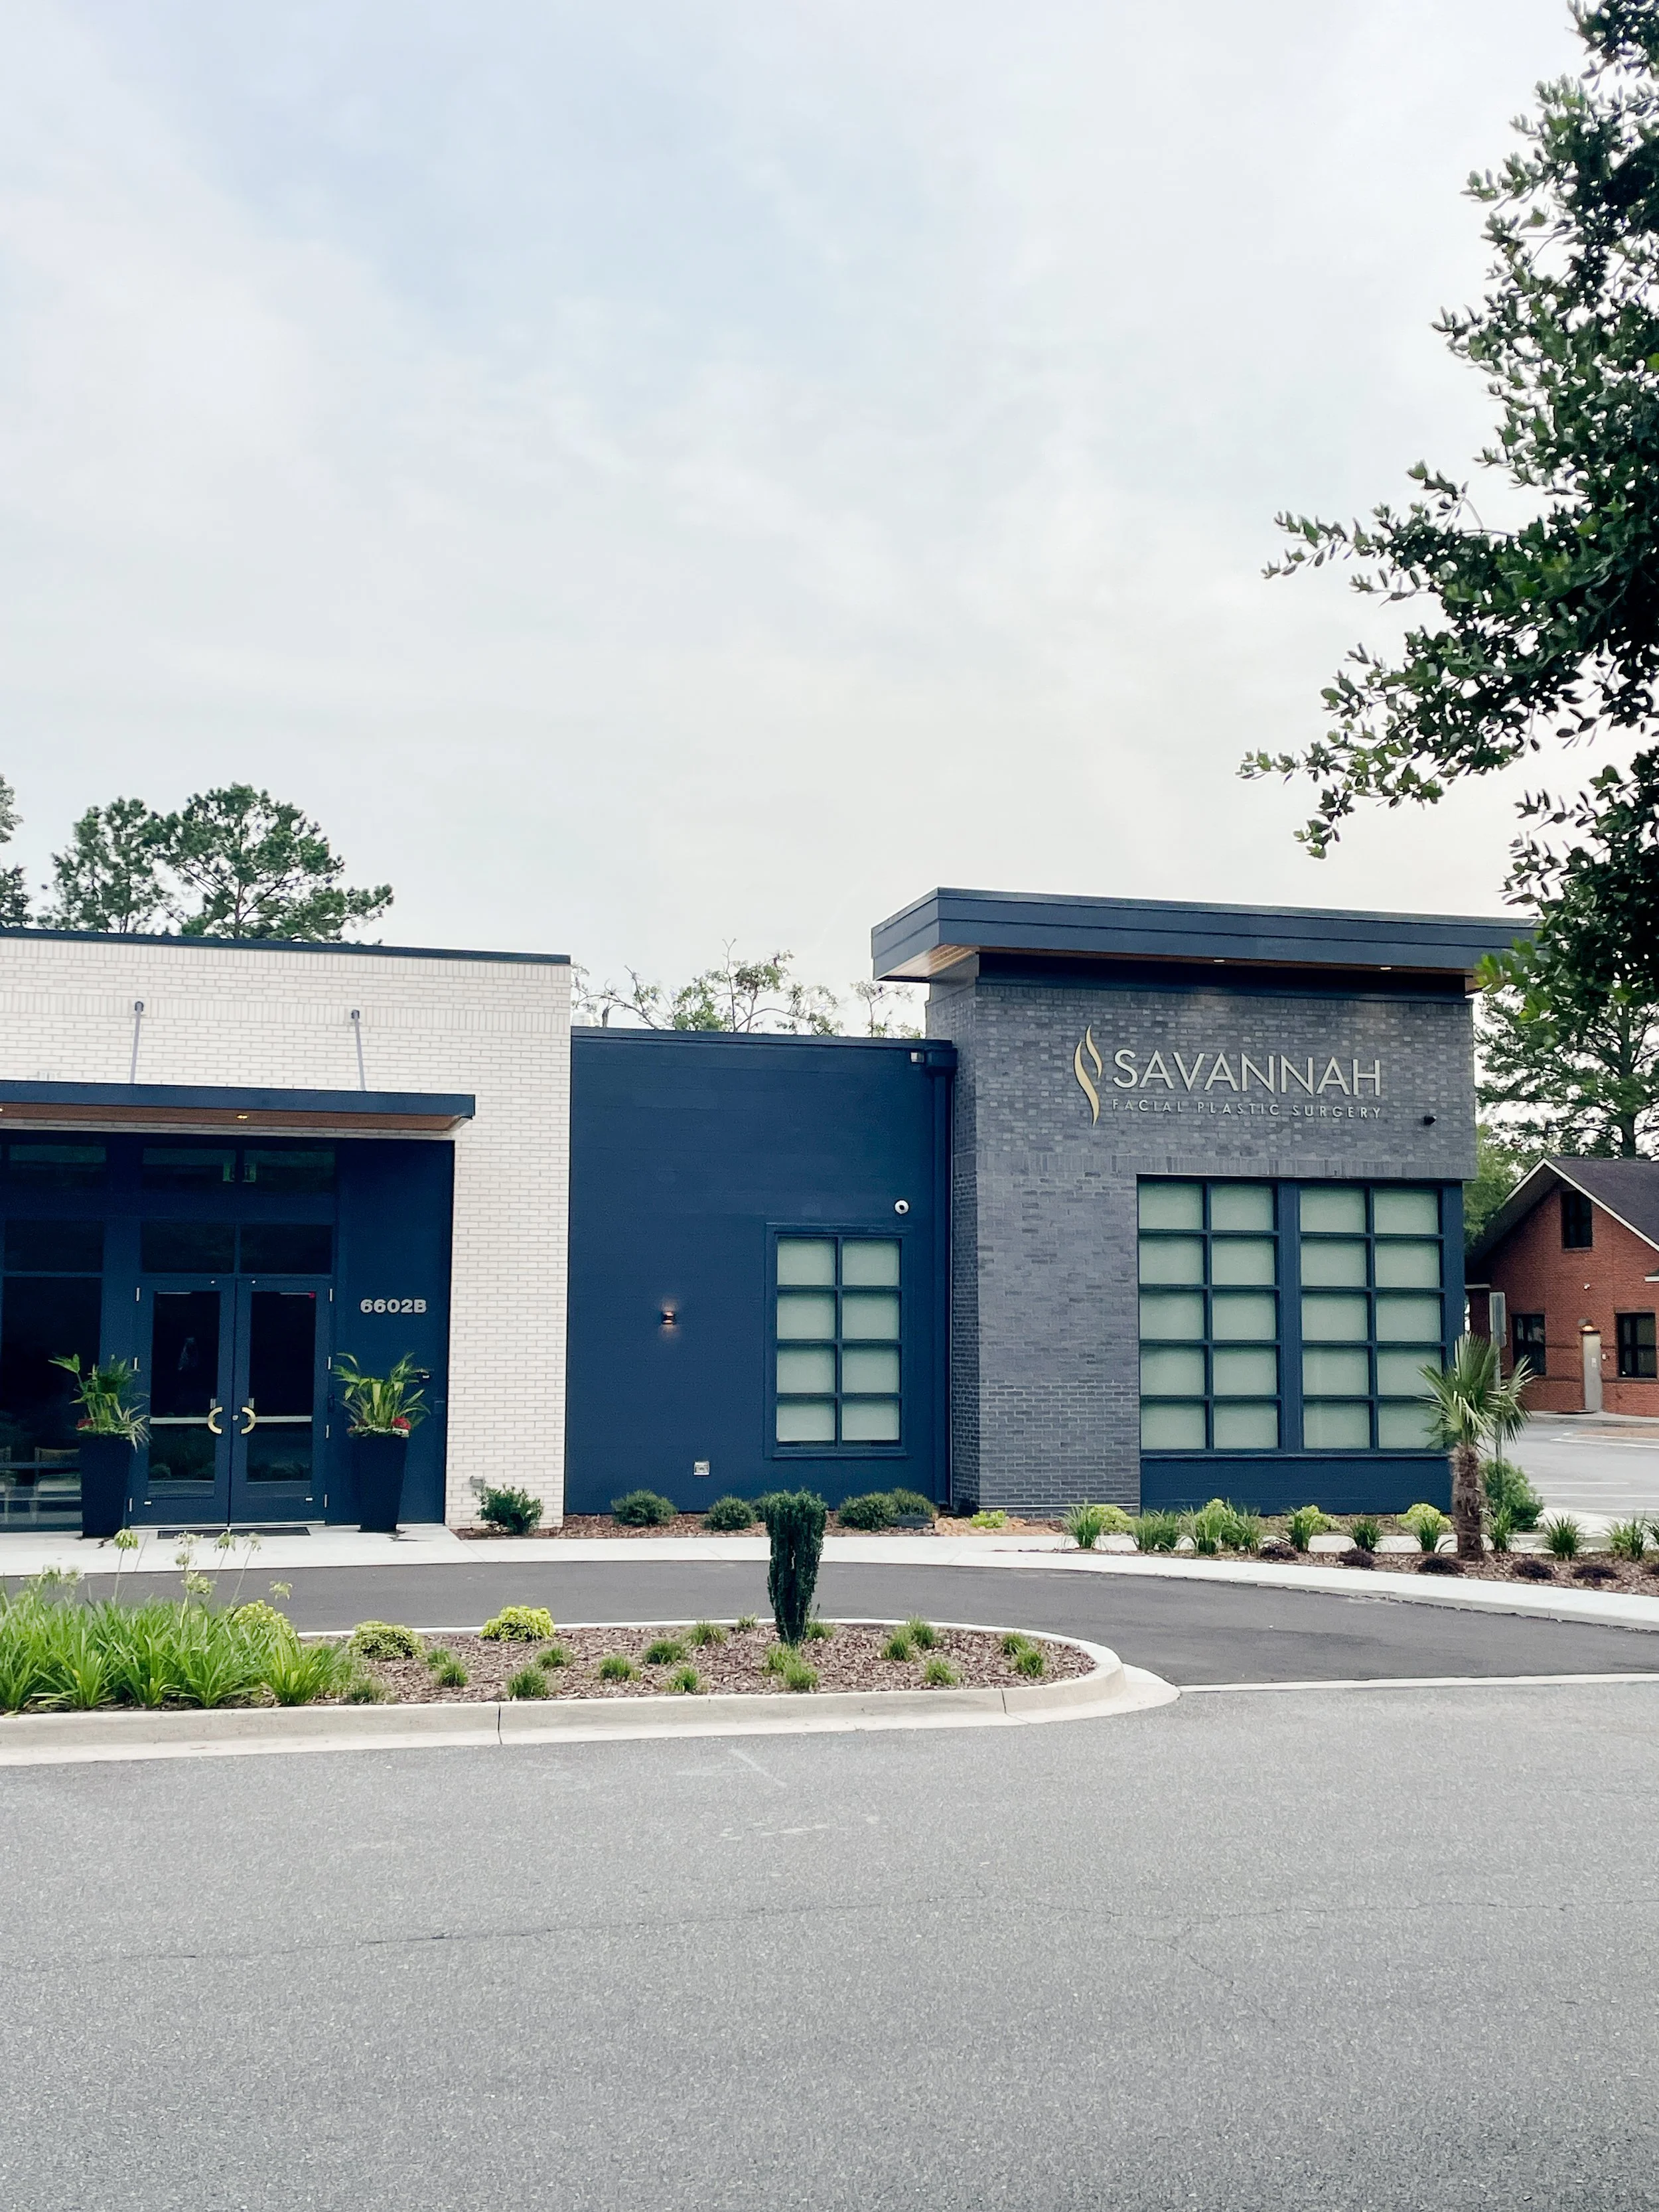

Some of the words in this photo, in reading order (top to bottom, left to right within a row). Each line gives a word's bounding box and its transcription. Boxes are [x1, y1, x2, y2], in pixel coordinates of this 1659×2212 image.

[1113, 1049, 1381, 1096] SAVANNAH
[1112, 1098, 1183, 1112] FACIAL
[1197, 1102, 1279, 1116] PLASTIC
[1293, 1105, 1381, 1119] SURGERY
[360, 1299, 427, 1313] 6602B
